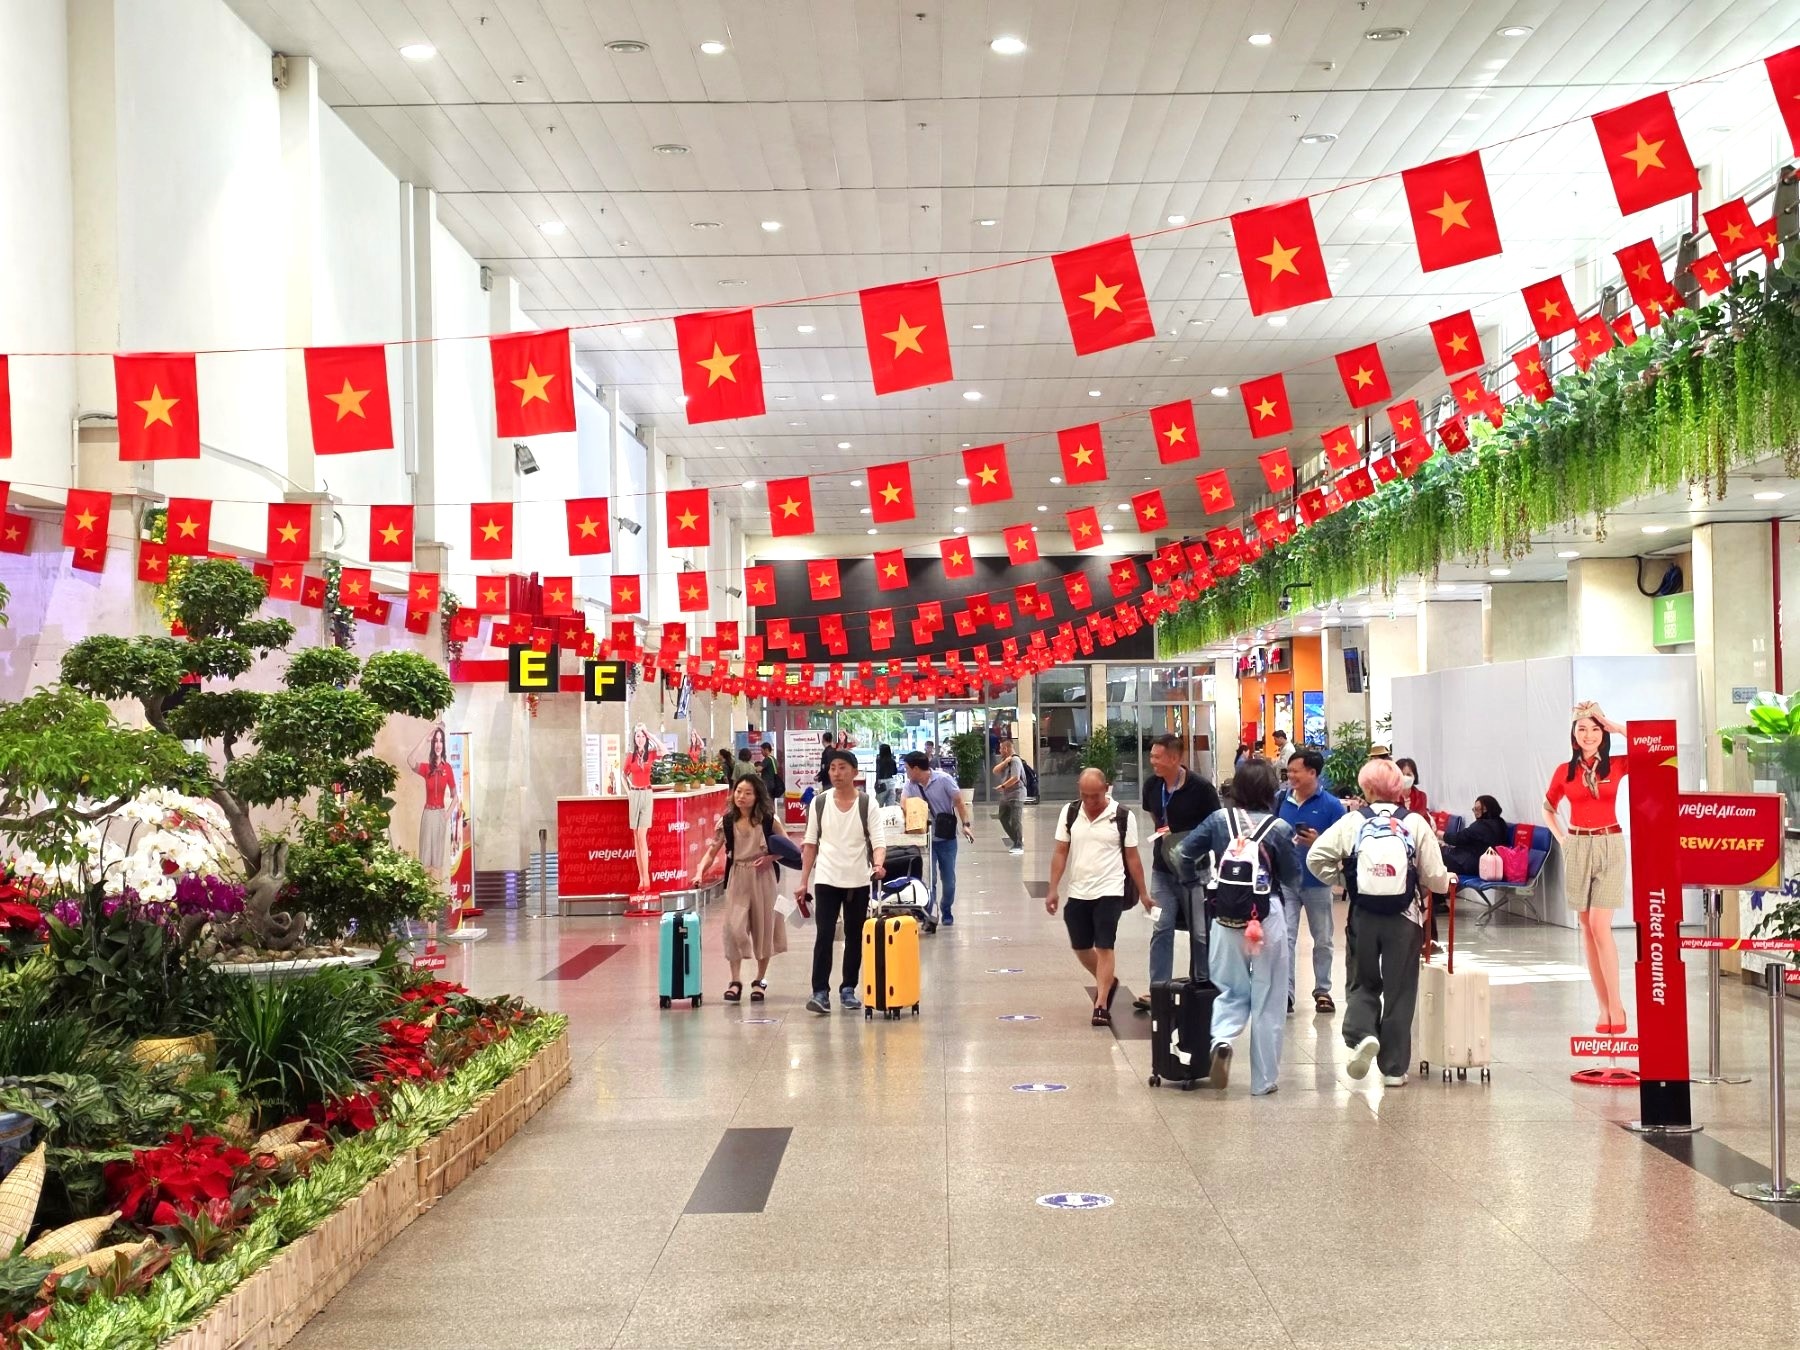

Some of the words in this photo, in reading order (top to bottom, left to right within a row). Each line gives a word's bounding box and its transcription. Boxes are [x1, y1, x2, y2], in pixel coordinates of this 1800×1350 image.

[520, 650, 548, 686] E
[594, 666, 617, 696] F
[1680, 836, 1765, 851] REW/STAFF
[1649, 888, 1665, 939] Ticket
[1650, 942, 1667, 1006] counter
